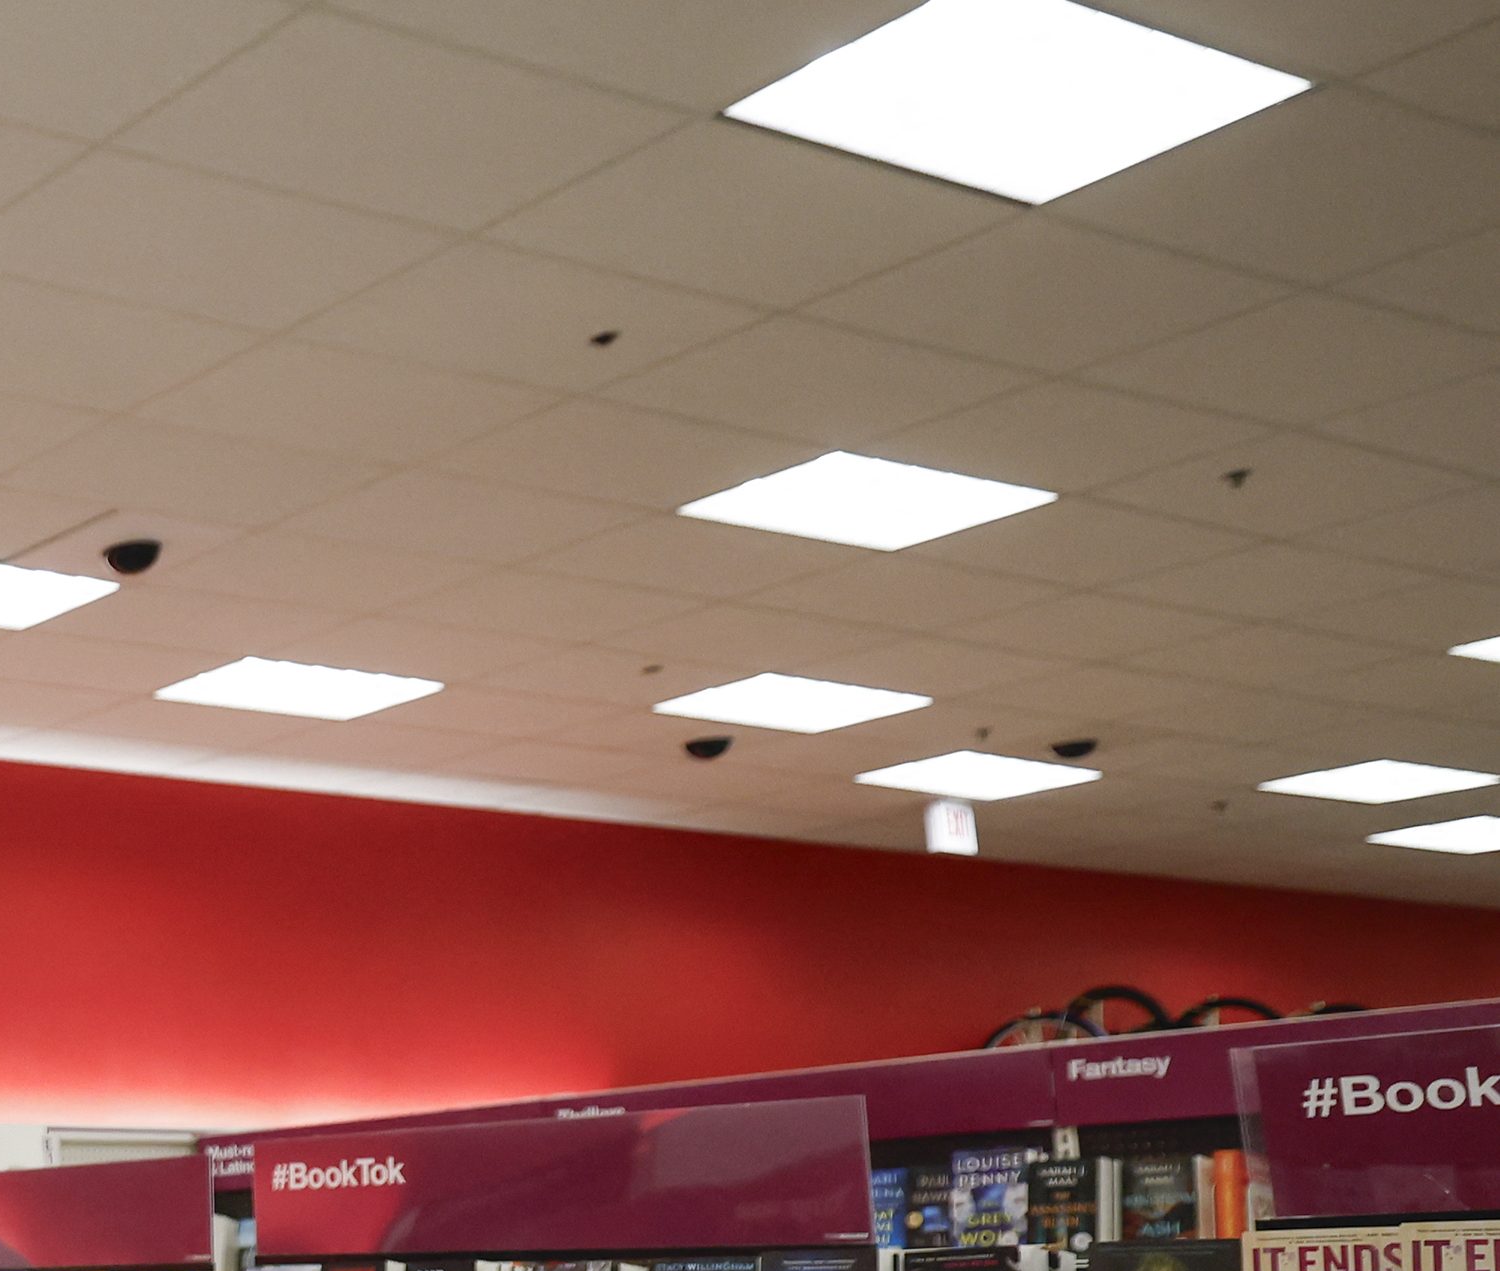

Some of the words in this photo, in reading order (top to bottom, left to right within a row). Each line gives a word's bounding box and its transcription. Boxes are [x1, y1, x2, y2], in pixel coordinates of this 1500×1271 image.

[1067, 1054, 1172, 1081] Fantasy
[272, 1156, 407, 1192] #BookTok
[956, 1153, 1022, 1172] LOUISE
[957, 1171, 1021, 1188] PENNY
